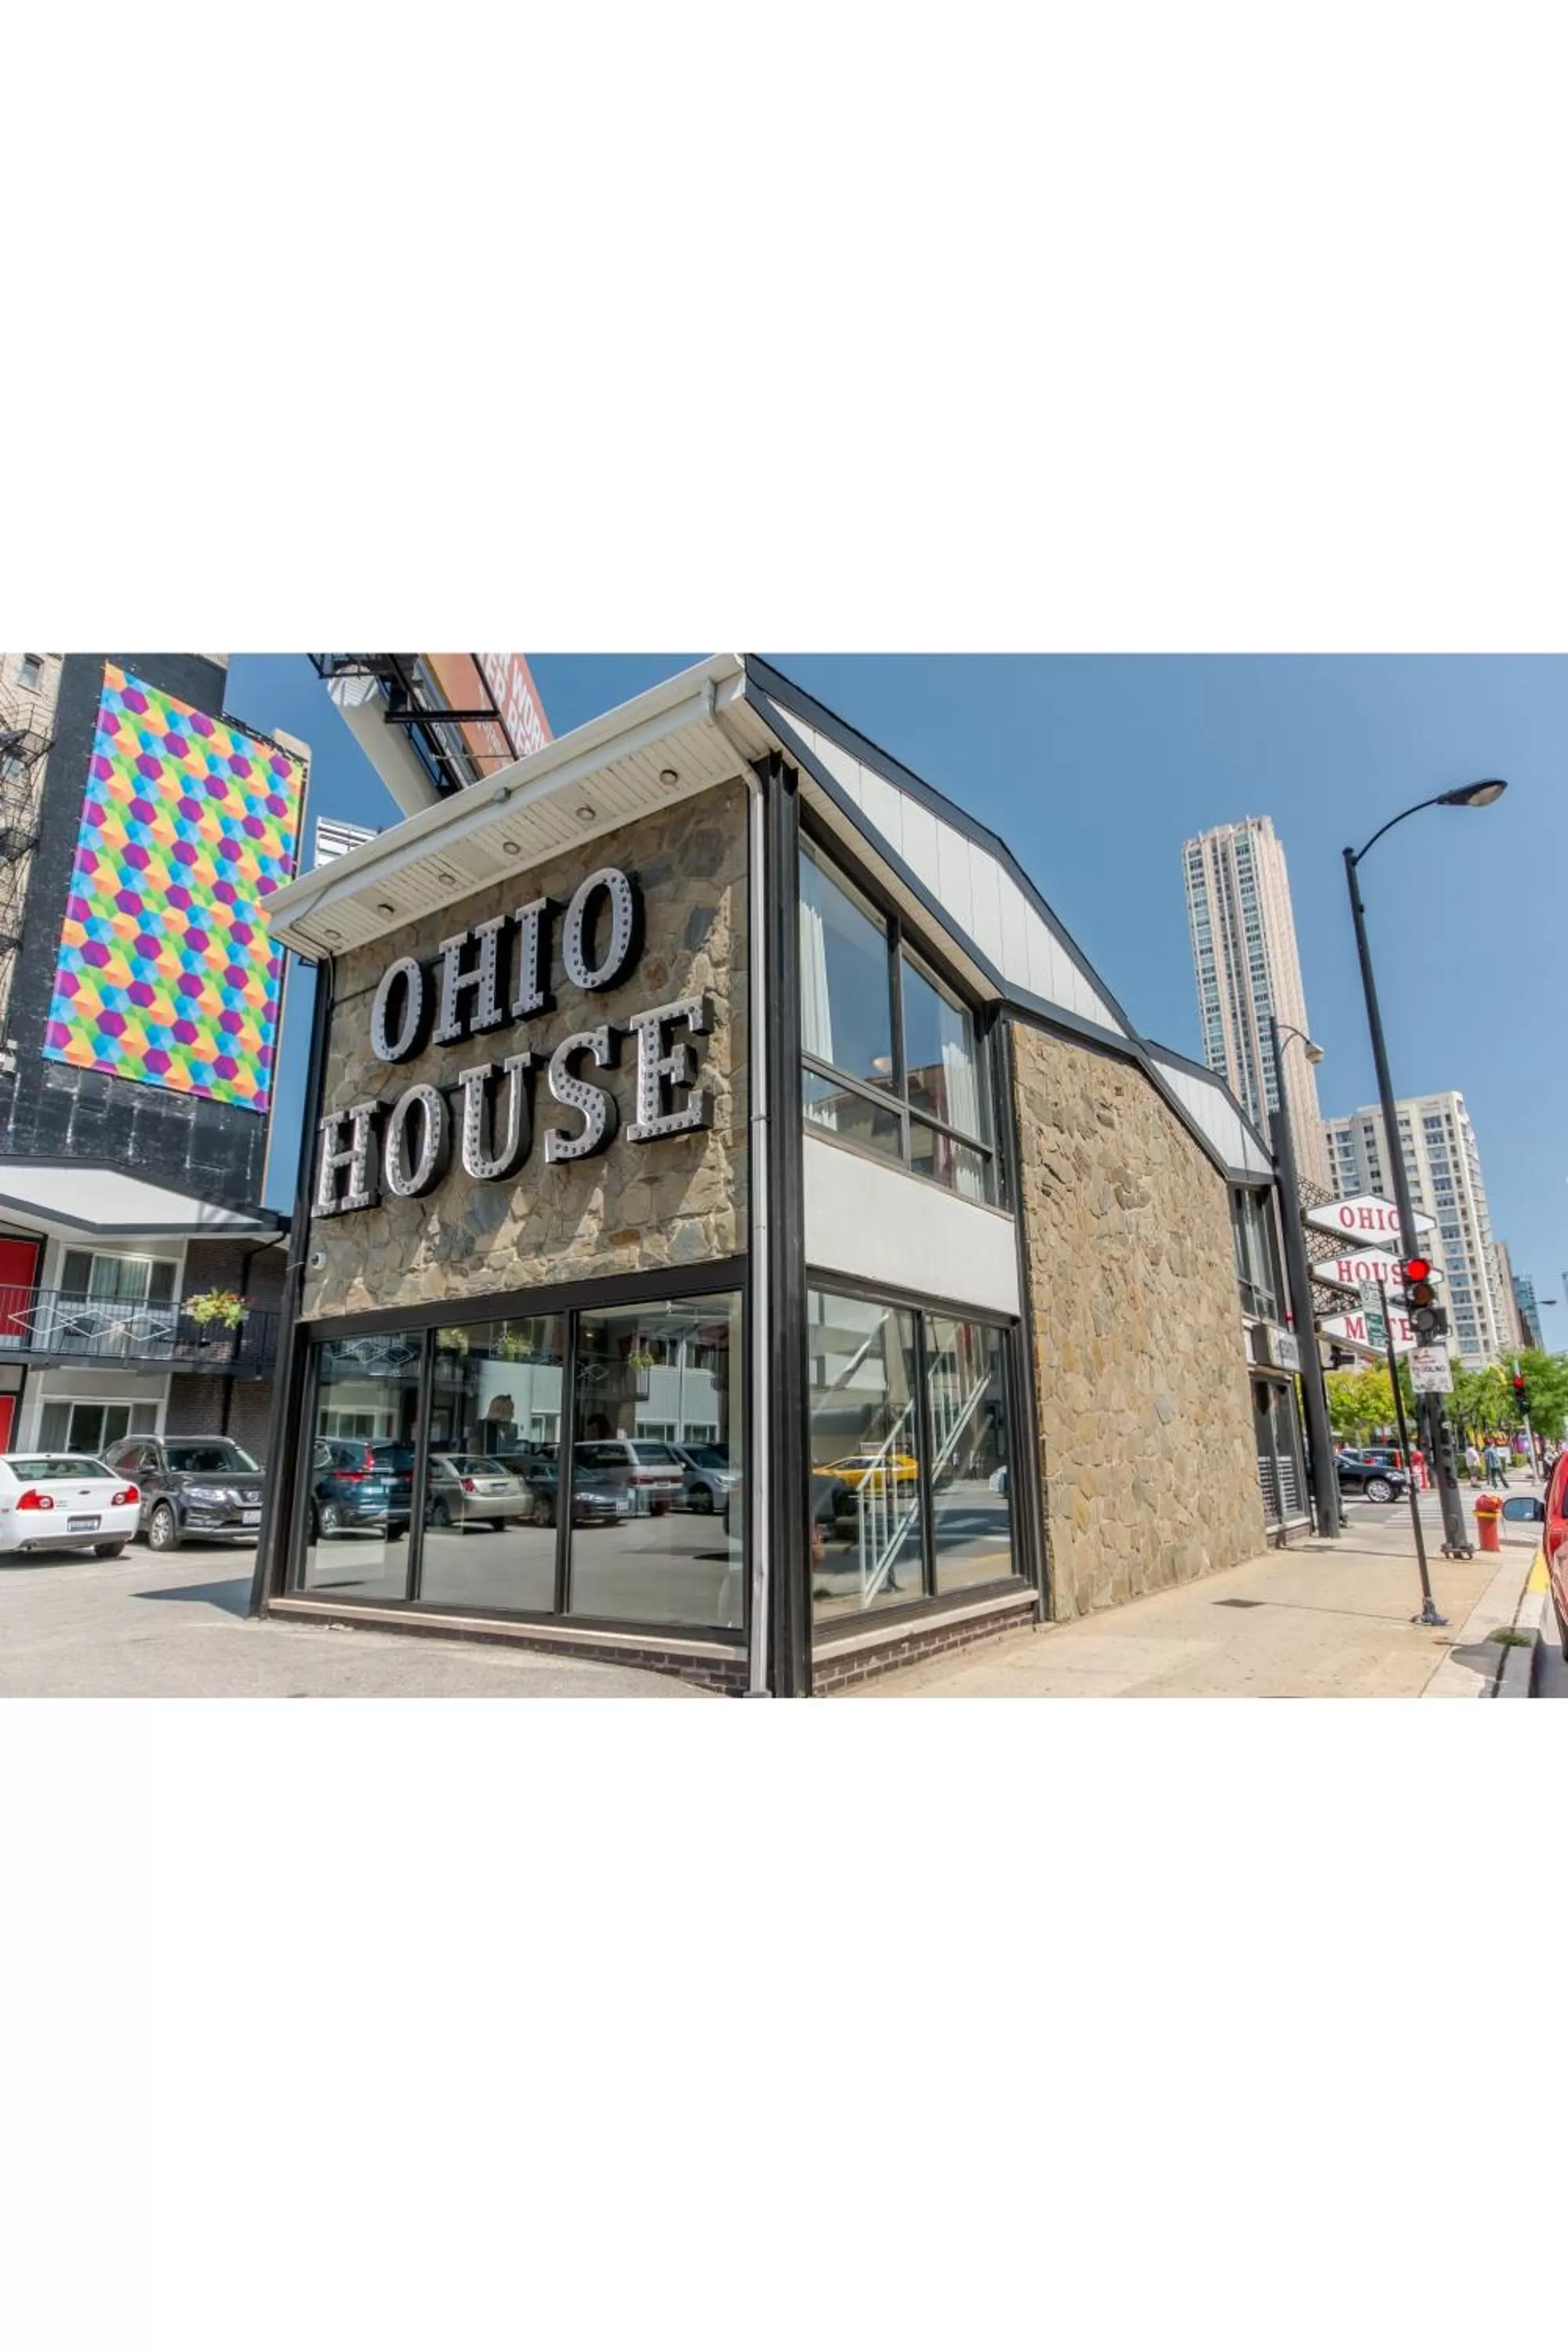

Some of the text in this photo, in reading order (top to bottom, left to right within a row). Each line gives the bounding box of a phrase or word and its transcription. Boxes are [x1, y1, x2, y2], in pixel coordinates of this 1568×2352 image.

[370, 867, 634, 1062] OHIO
[311, 995, 712, 1218] HOUSE
[1335, 1259, 1403, 1286] HOUS
